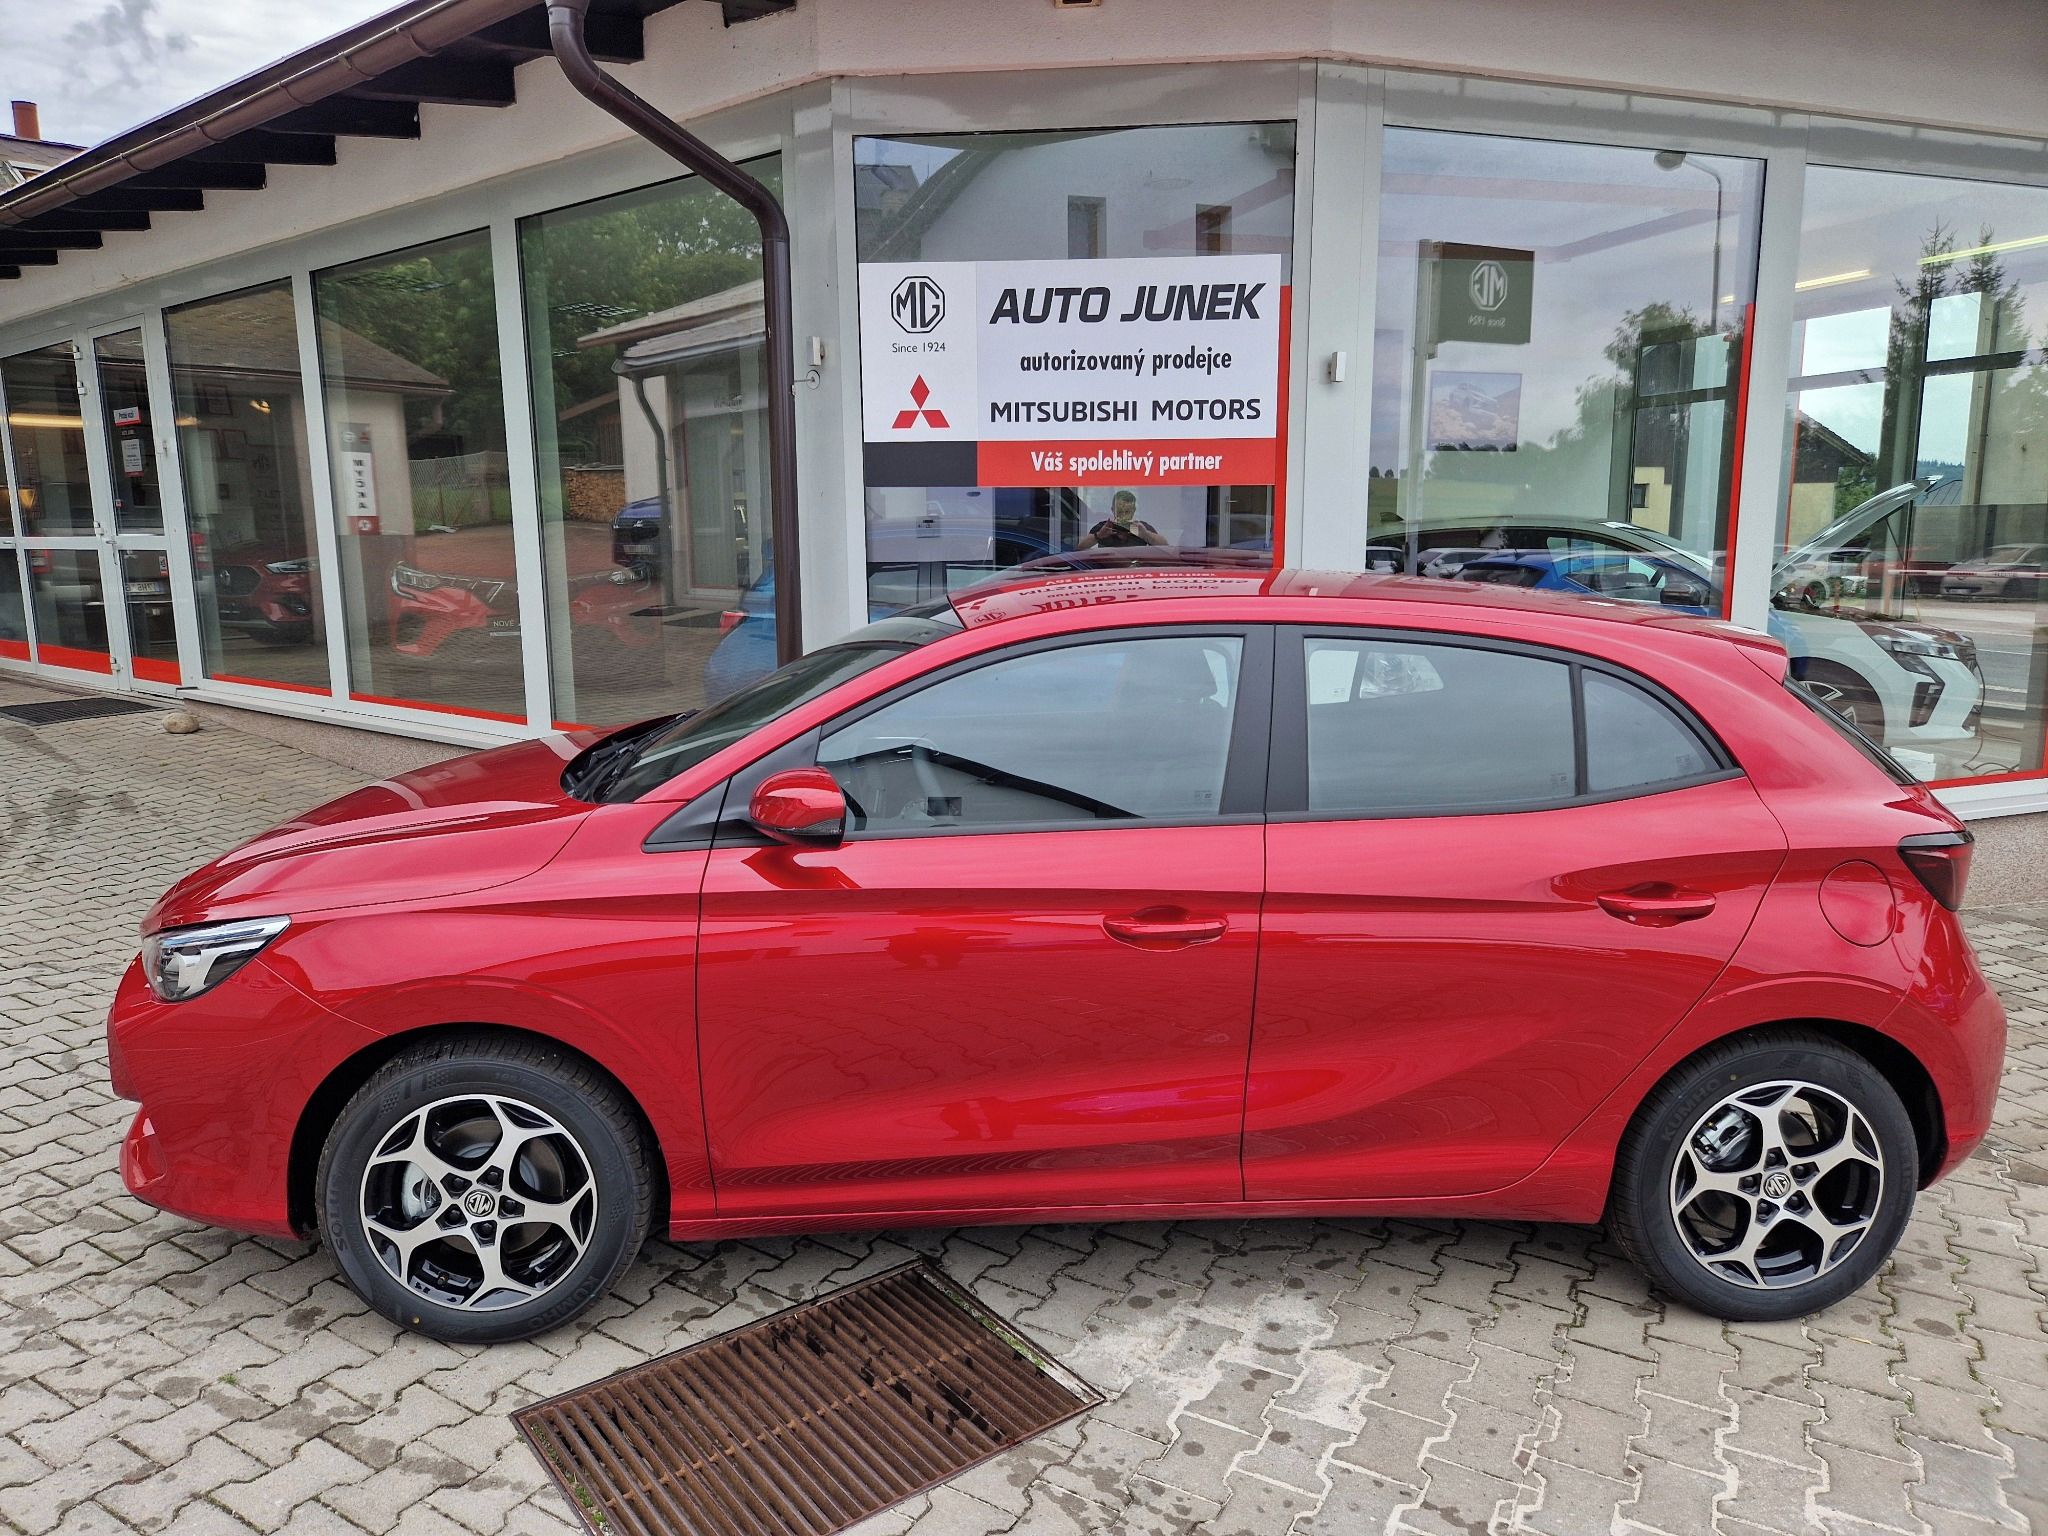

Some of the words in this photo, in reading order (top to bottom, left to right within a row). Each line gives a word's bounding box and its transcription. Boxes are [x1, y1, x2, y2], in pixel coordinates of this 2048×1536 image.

[892, 277, 945, 333] MG
[989, 286, 1111, 324] AUTO
[1120, 283, 1267, 322] JUNEK
[892, 342, 918, 353] Since
[922, 341, 946, 353] 1924
[1020, 348, 1145, 376] autorizovaný
[1153, 346, 1232, 376] prodejce
[990, 400, 1138, 423] MITSUBISHI
[1152, 398, 1261, 421] MOTORS
[1031, 451, 1063, 471] Váš
[1069, 449, 1154, 477] spolehlivý
[1159, 452, 1223, 476] partner
[1765, 1174, 1789, 1198] MG
[466, 1192, 493, 1216] MG
